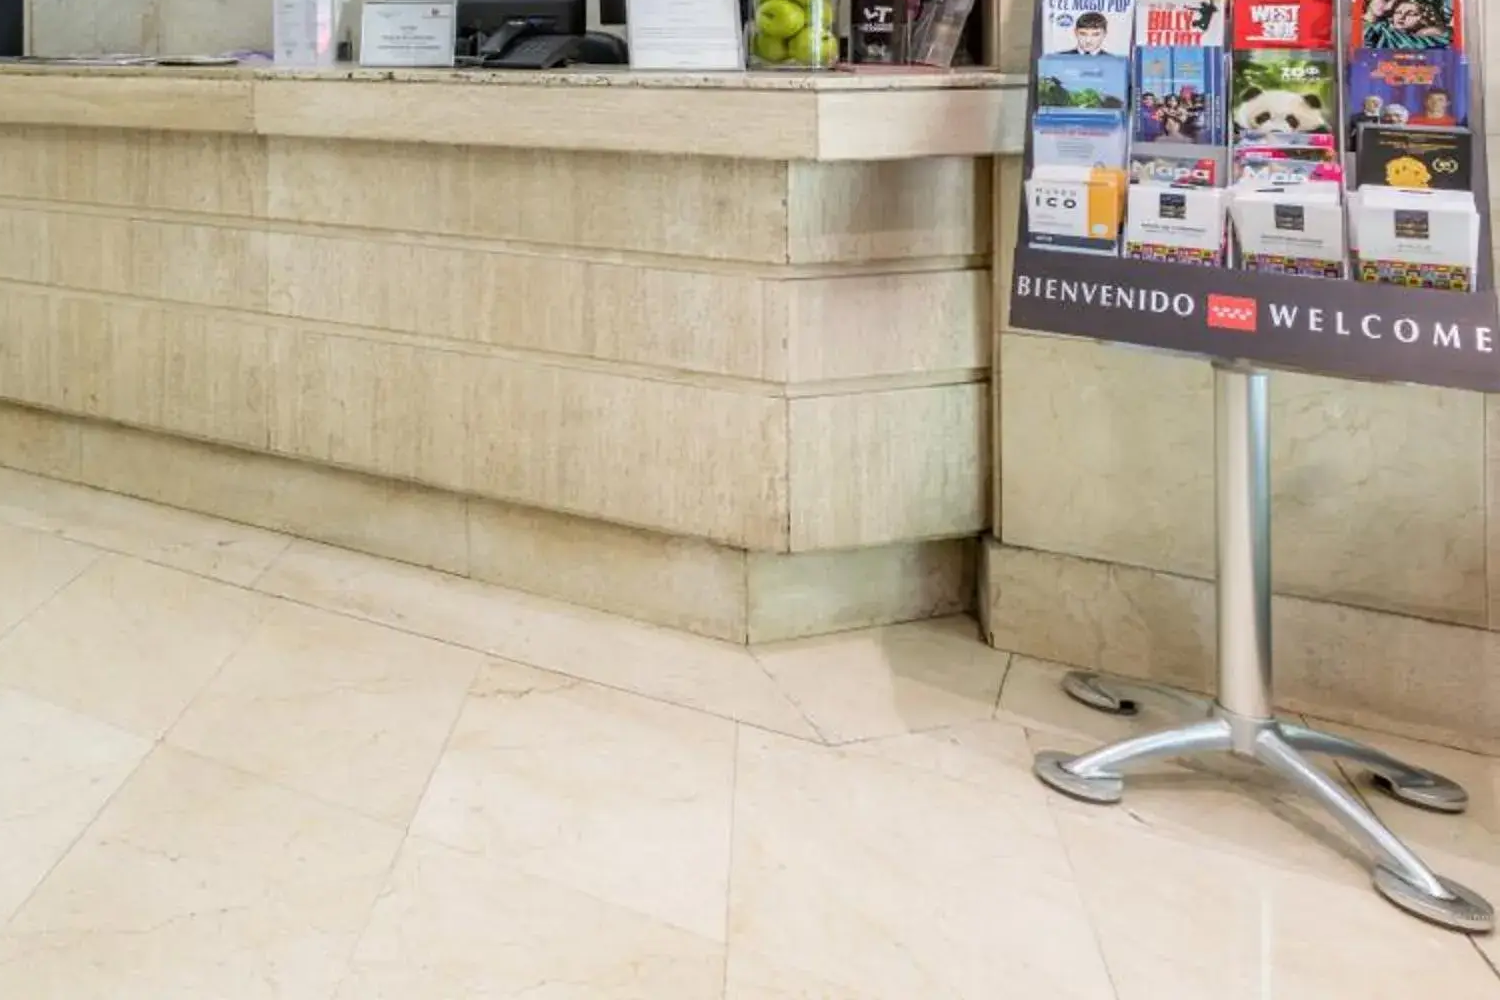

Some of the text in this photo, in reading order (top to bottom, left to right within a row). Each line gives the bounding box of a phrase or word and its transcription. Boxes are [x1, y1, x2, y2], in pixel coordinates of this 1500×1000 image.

[1147, 10, 1194, 31] BILLY
[1250, 5, 1300, 23] WEST
[1016, 274, 1493, 353] BIENVENIDO WELCOME
